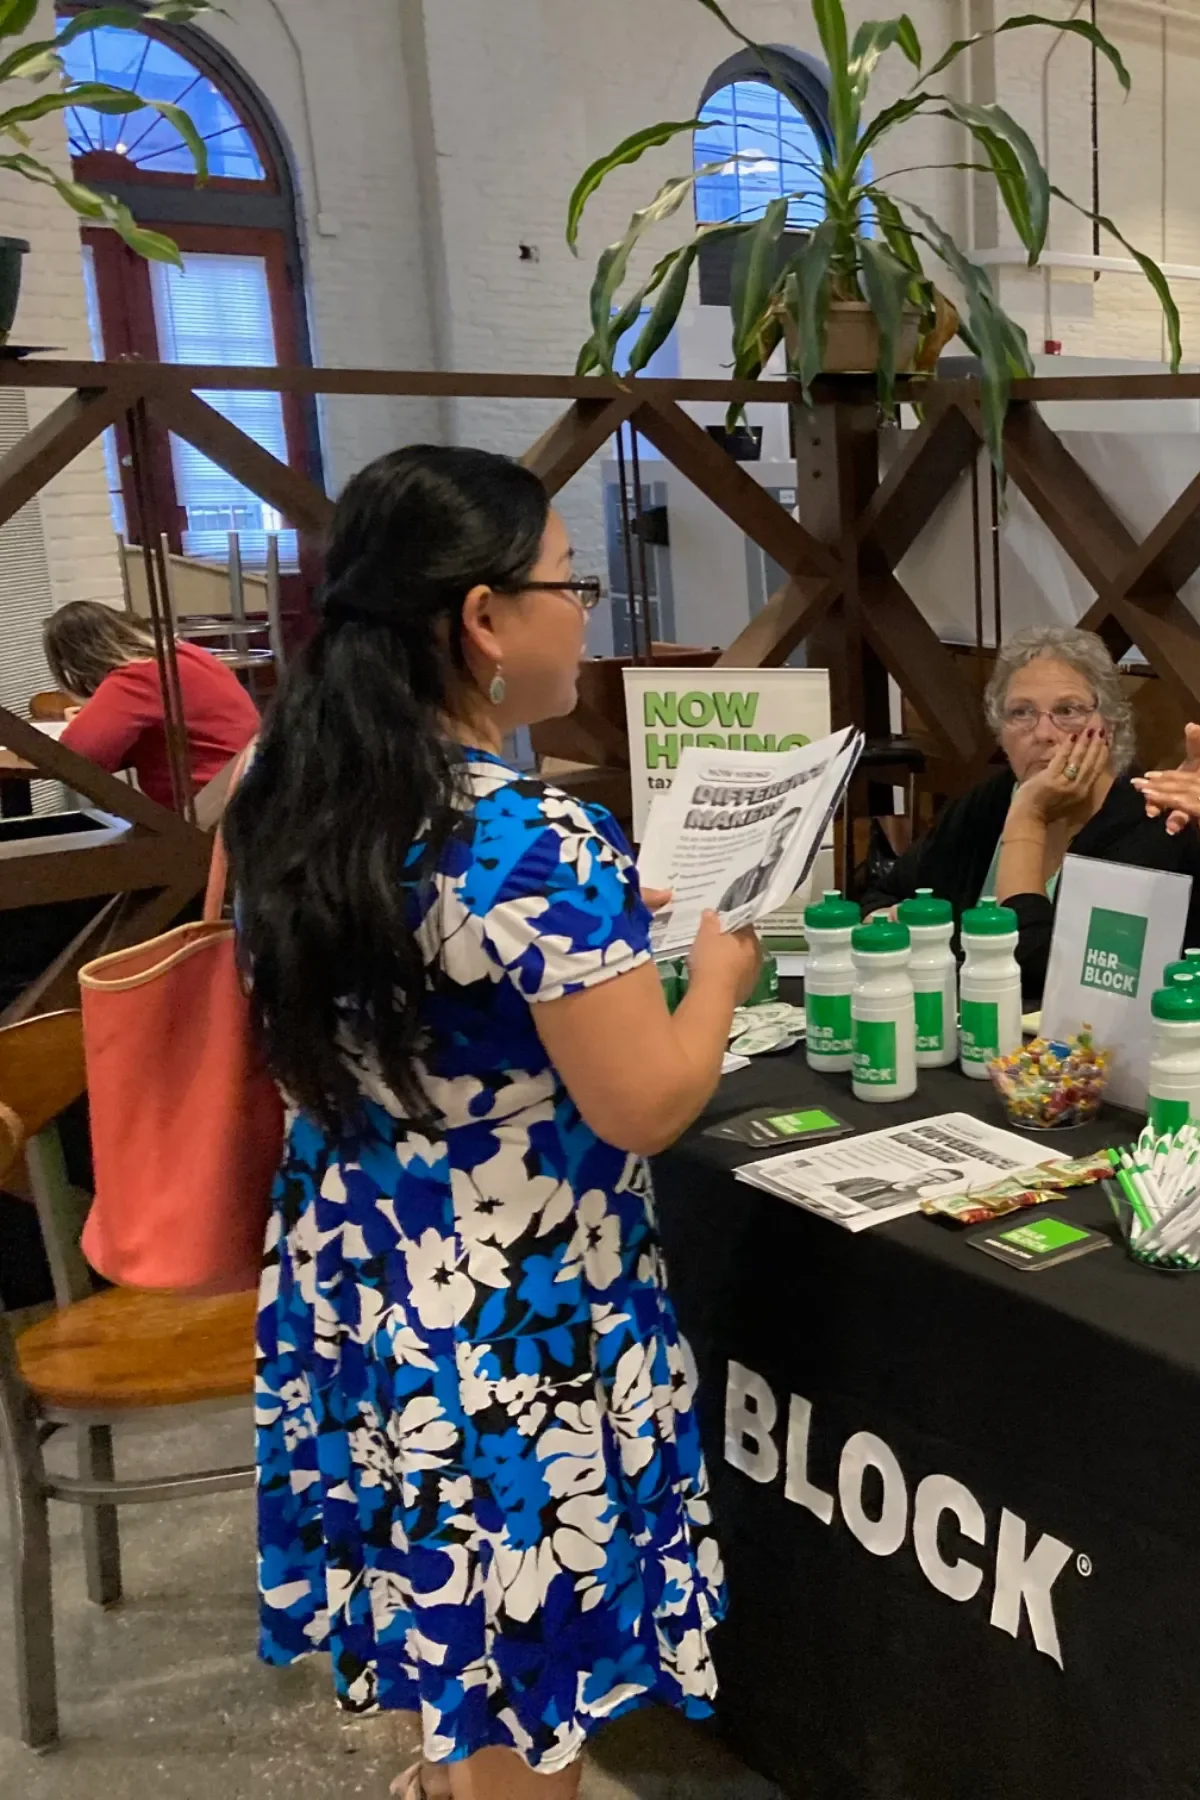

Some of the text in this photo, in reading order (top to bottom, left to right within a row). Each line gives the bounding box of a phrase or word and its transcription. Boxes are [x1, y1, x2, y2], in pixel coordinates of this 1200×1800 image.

[643, 691, 760, 728] NOW
[1087, 948, 1119, 969] H&R
[1084, 965, 1136, 992] BLOCK
